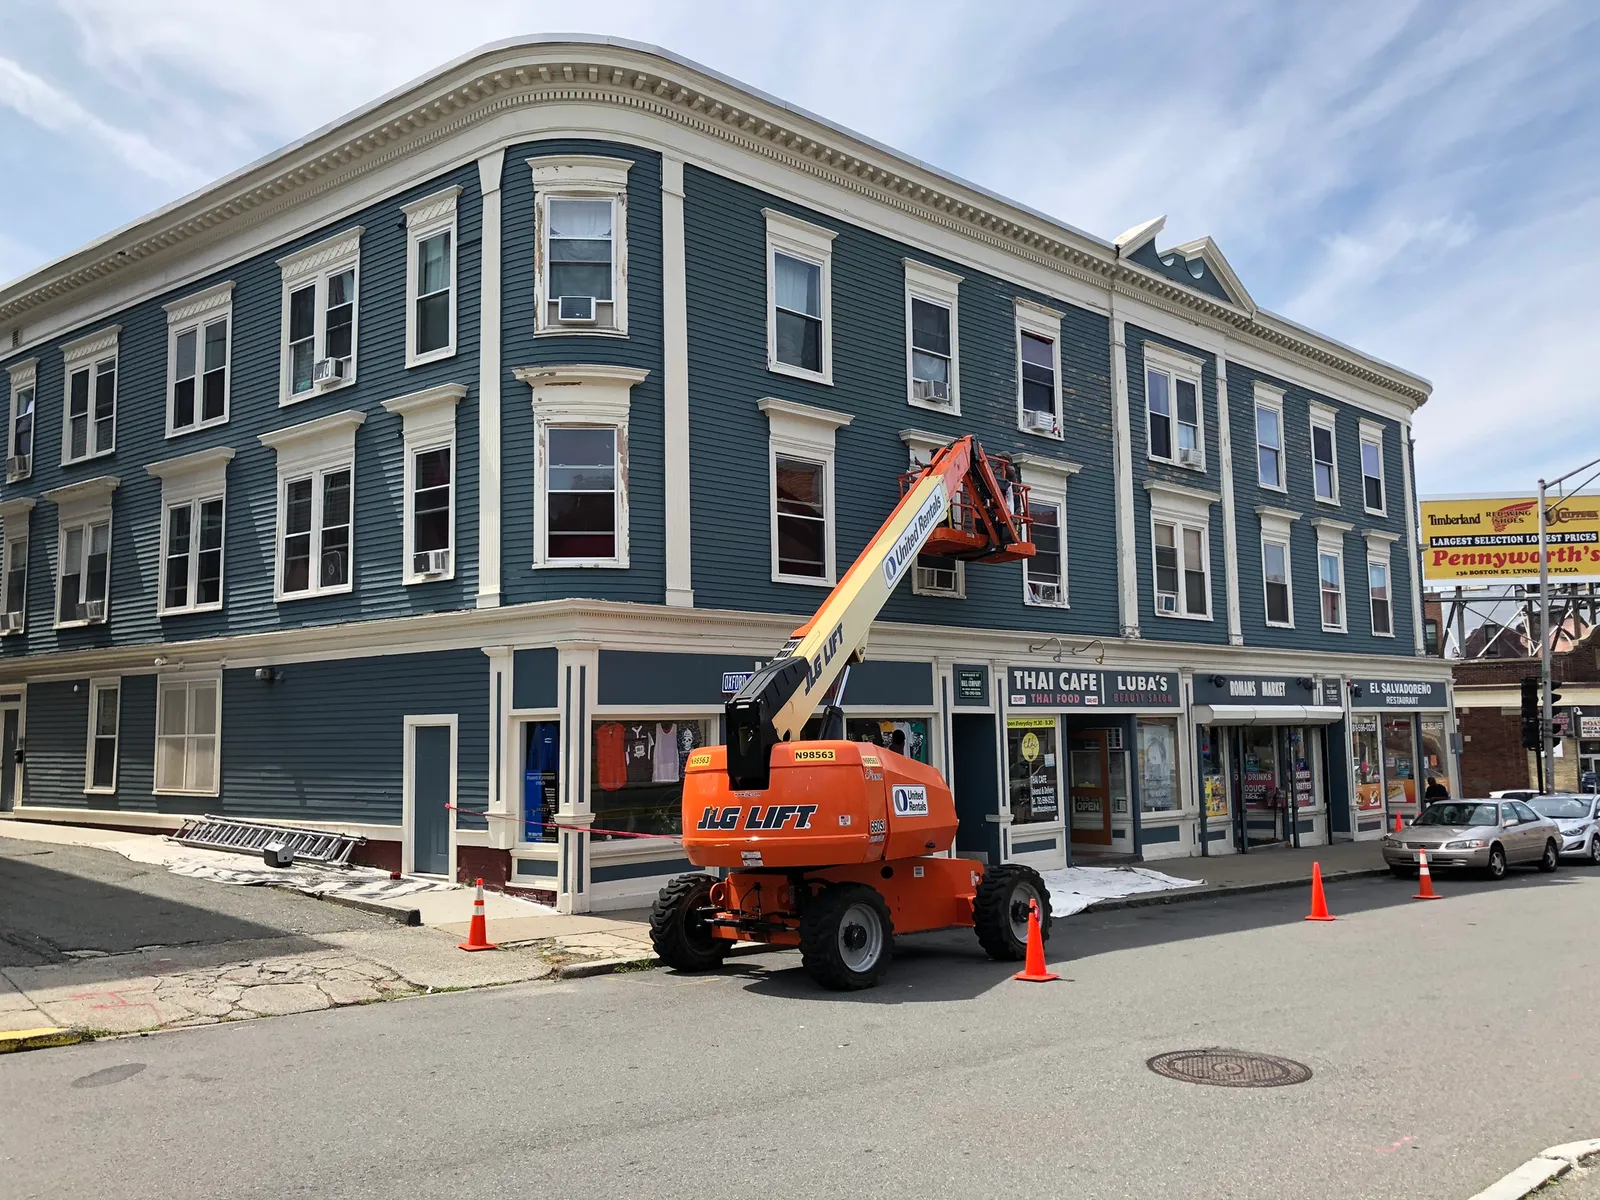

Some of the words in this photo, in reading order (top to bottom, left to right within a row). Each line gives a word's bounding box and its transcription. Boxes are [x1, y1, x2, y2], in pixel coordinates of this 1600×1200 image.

[1428, 513, 1481, 526] Timberland
[896, 523, 919, 566] United
[918, 495, 941, 533] Rentals
[1432, 536, 1472, 546] LARGEST
[1474, 535, 1524, 545] SELECTION
[1526, 534, 1562, 544] LOEST
[1564, 532, 1597, 542] PRICES
[1512, 566, 1552, 575] LYNNGE
[804, 654, 822, 696] JLG
[823, 623, 843, 667] LIFT
[1013, 671, 1053, 690] THAI
[1059, 672, 1097, 691] CAFE
[1117, 675, 1168, 691] LUBA'S
[1261, 681, 1285, 697] MARKET
[1369, 682, 1380, 694] EL
[1381, 682, 1431, 694] SALVADOREÑO
[1031, 694, 1053, 703] THAI
[1056, 694, 1080, 704] FOOD
[1113, 693, 1144, 702] BEAUTY
[1148, 694, 1173, 703] SALON
[1386, 696, 1418, 705] RESTAURANT
[795, 751, 834, 760] N98563
[908, 789, 924, 800] United
[909, 801, 926, 811] Rentals
[1076, 802, 1099, 811] OPEN
[697, 806, 742, 830] JLG
[744, 804, 818, 830] LIFT
